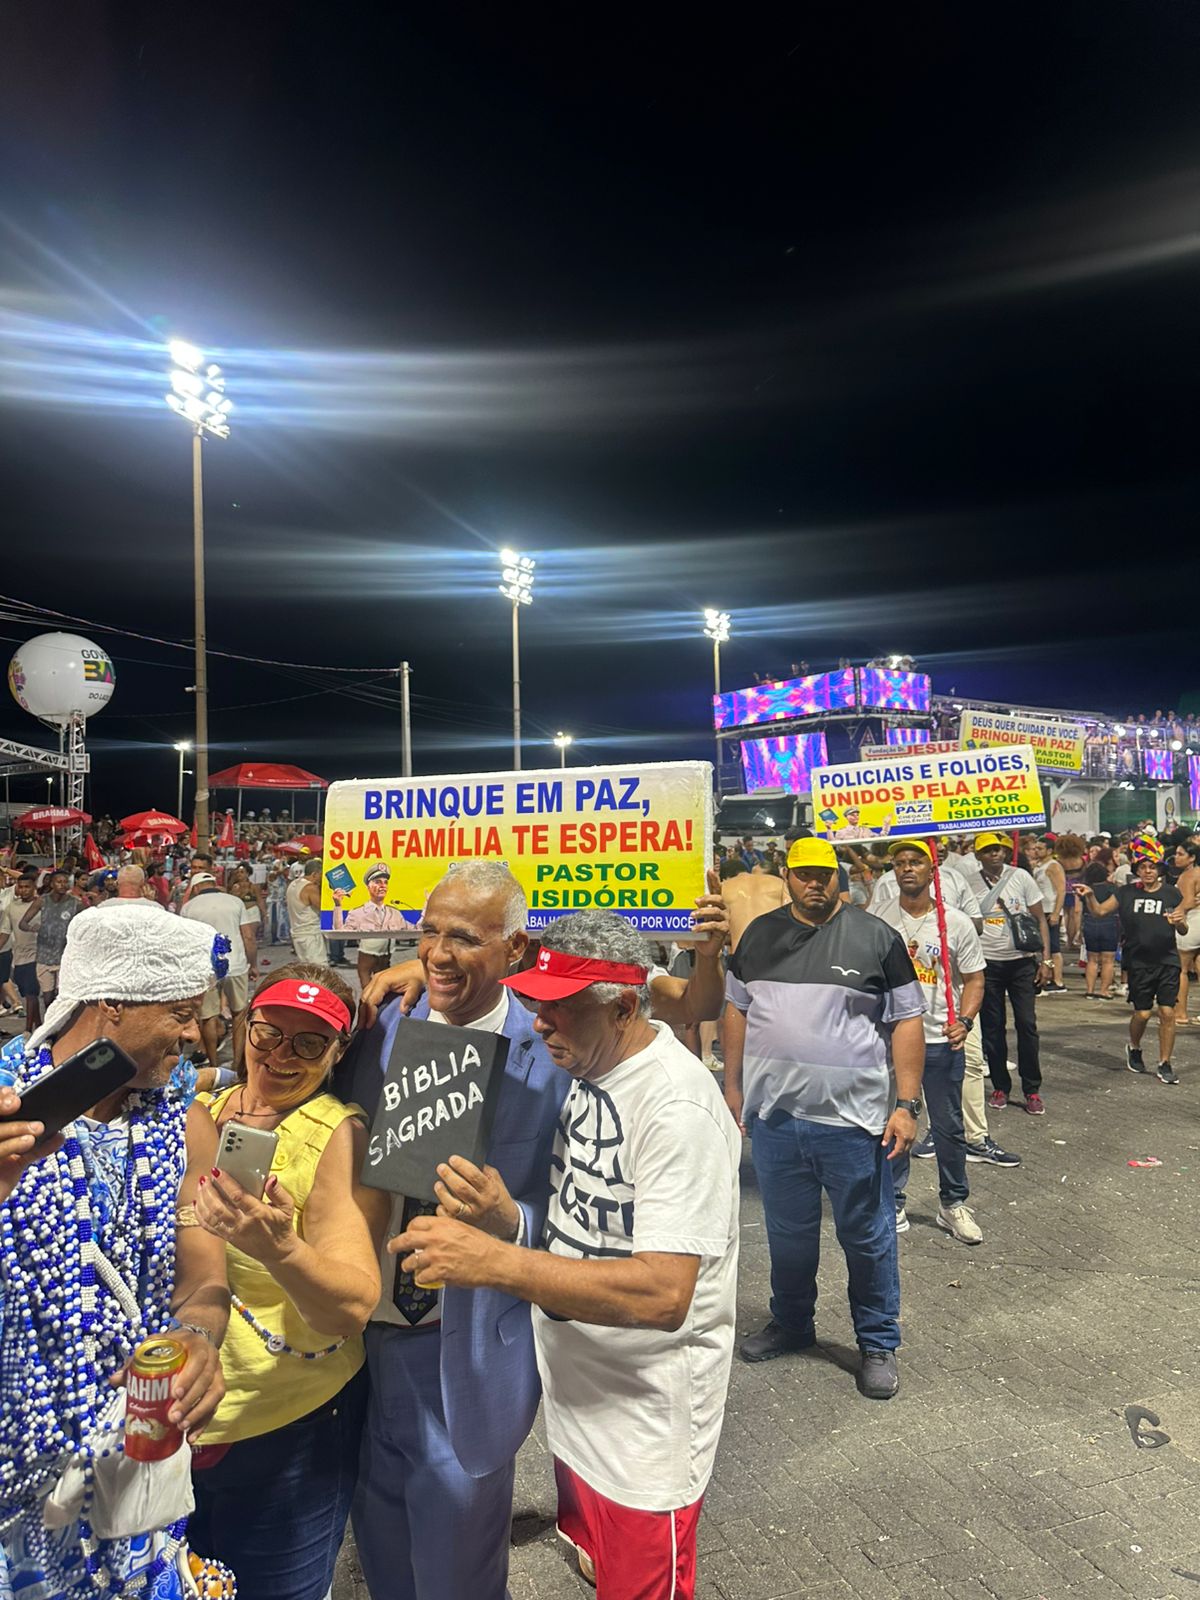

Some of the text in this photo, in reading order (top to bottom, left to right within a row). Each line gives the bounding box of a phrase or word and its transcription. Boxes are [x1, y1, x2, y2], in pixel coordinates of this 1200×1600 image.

[972, 716, 993, 729] DEUS
[995, 719, 1016, 732] QUER
[1017, 723, 1045, 734] CUIDAR
[1047, 726, 1057, 737] DE
[972, 728, 1076, 751] BRINQUE EM PAZ!
[906, 741, 959, 755] JESUS
[1036, 749, 1072, 760] PASTOR
[1035, 757, 1075, 768] SIDÓRIO
[819, 766, 914, 790] POLICIAIS
[920, 764, 932, 780] E
[939, 754, 1030, 778] FOLIÕES,
[821, 774, 1028, 808] UNIDOS PELA PAZ!
[364, 777, 651, 821] BRINQUE EM PAZ,
[949, 793, 1020, 808] PASTOR
[33, 810, 70, 820] BRAHMA
[896, 804, 933, 815] PAZ!
[948, 804, 1030, 819] ISIDÓRIO
[937, 820, 981, 830] TRABALHANDO
[981, 819, 987, 827] E
[987, 818, 1012, 826] ORANDO
[1012, 816, 1026, 824] POR
[329, 819, 694, 860] SUA FAMÍLIA TE ESPERA!
[536, 862, 660, 882] PASTOR
[531, 884, 675, 908] ISIDÓRIO
[1133, 899, 1162, 915] FBI
[641, 915, 663, 929] POR
[925, 945, 940, 956] 70
[369, 1081, 484, 1166] SAGRADA
